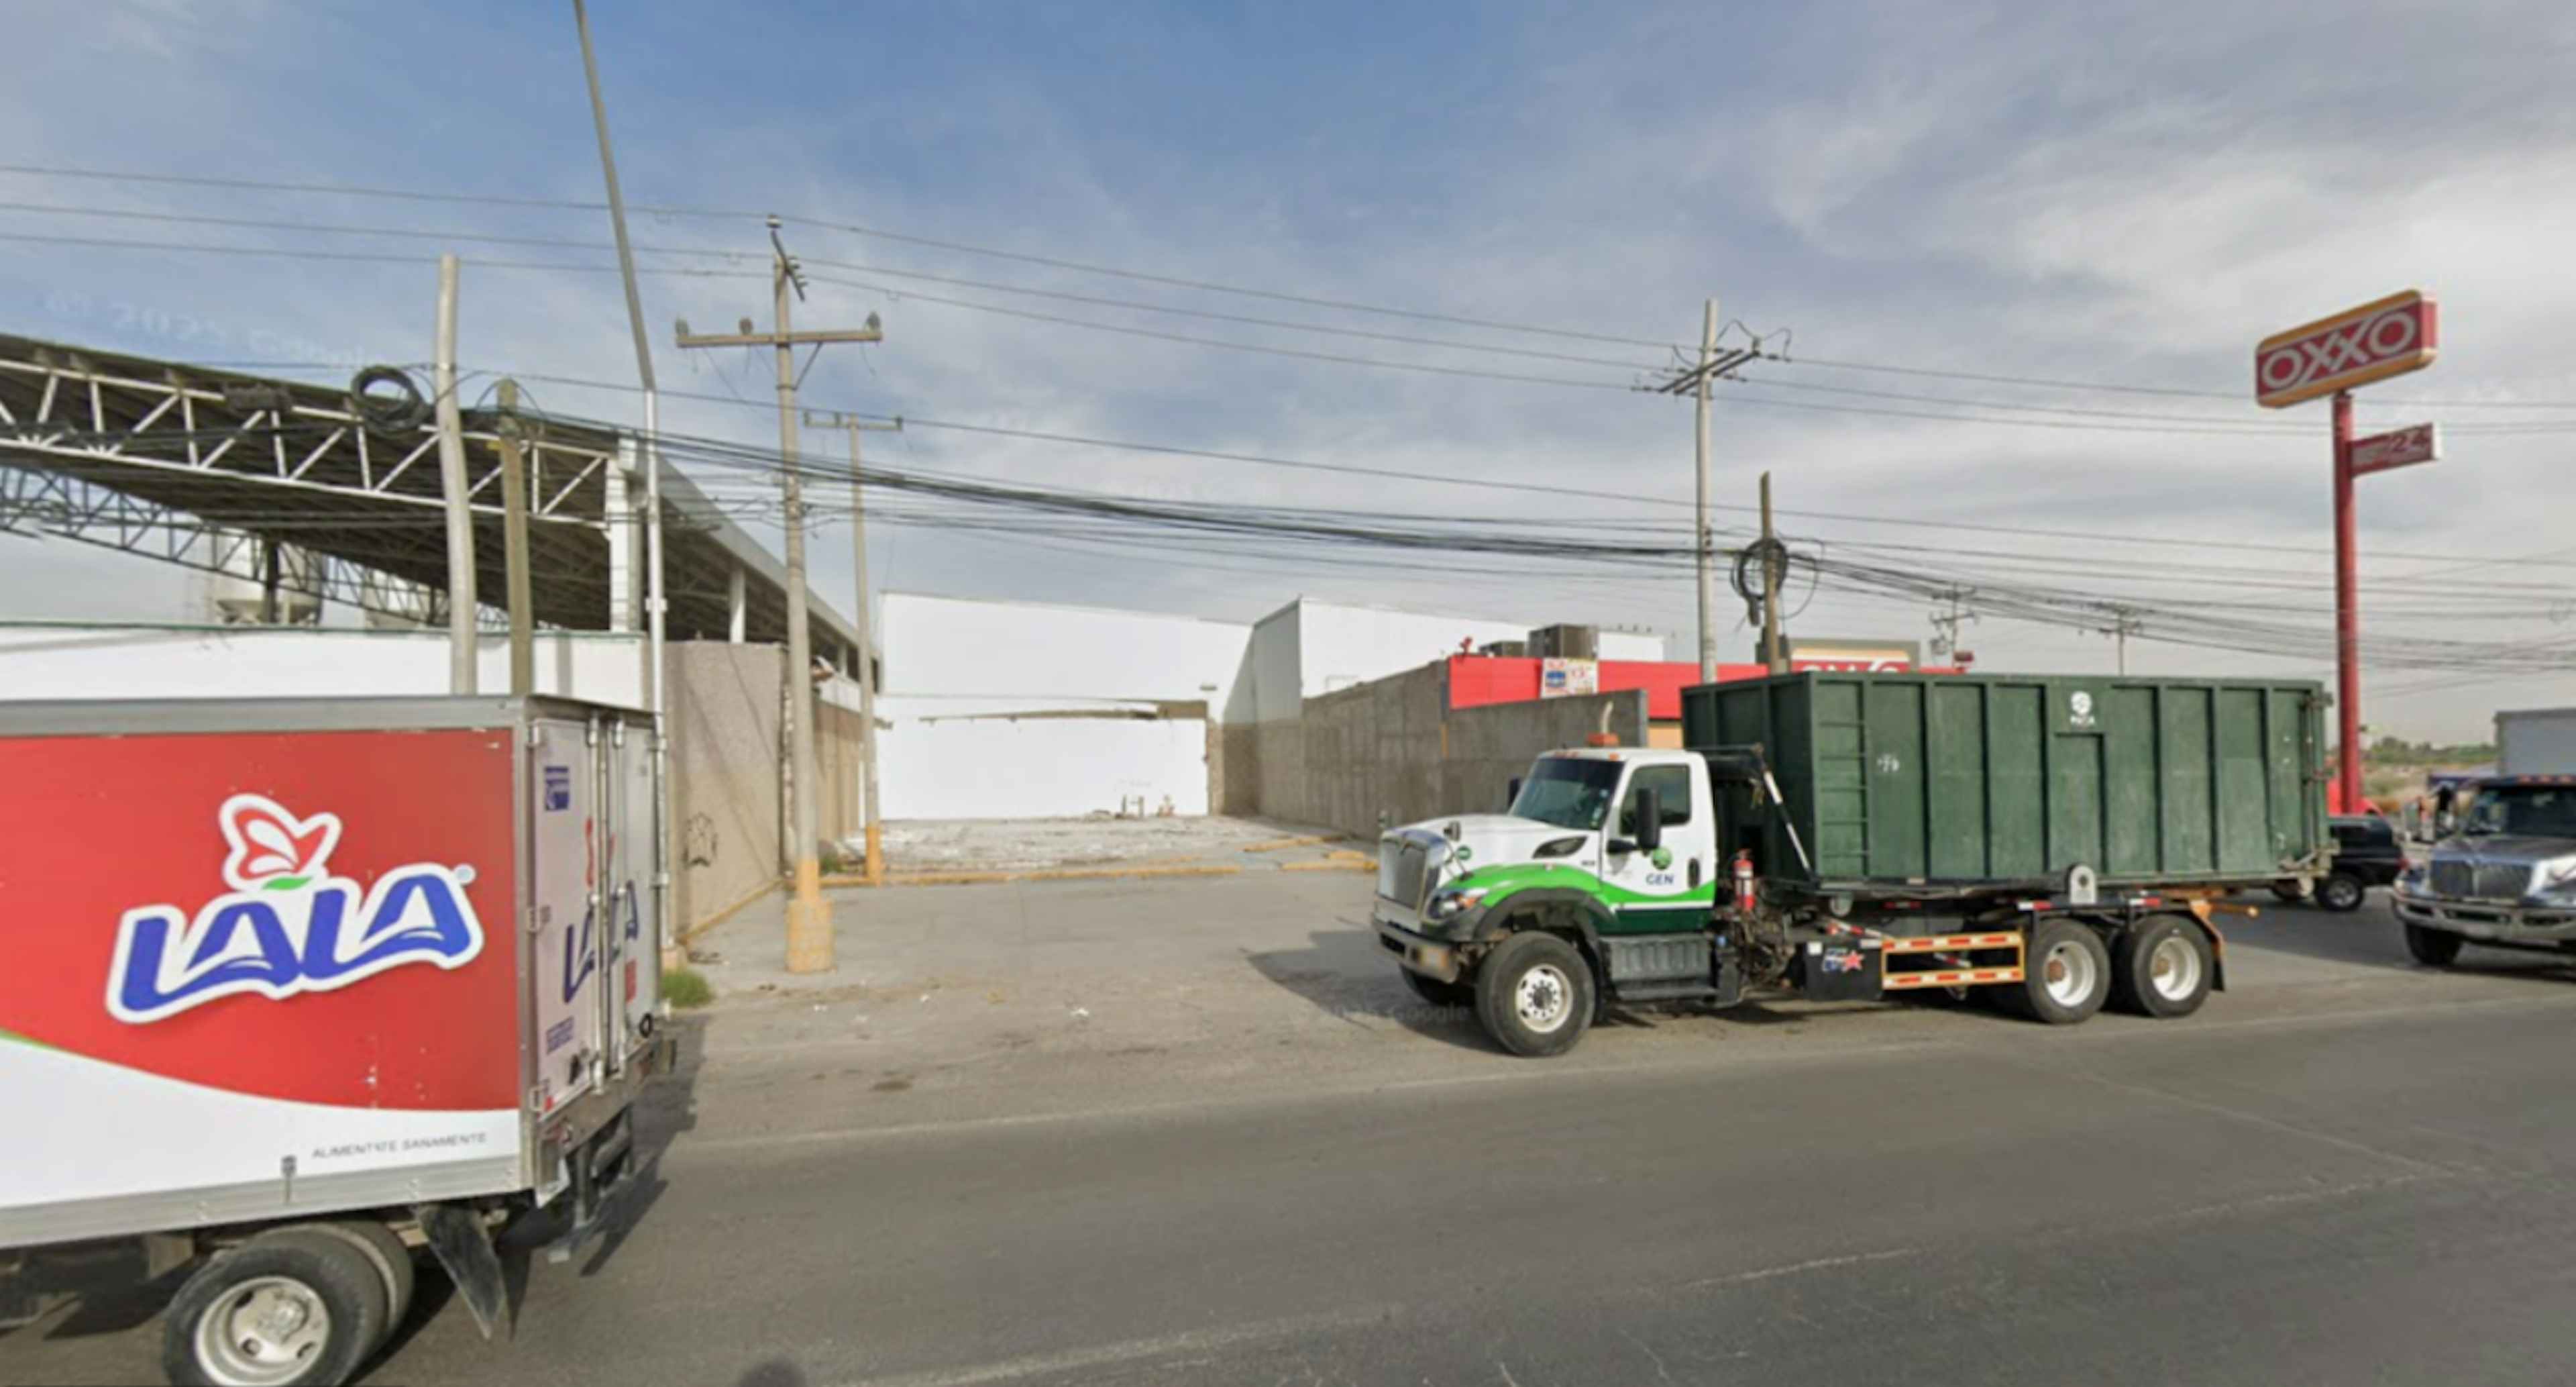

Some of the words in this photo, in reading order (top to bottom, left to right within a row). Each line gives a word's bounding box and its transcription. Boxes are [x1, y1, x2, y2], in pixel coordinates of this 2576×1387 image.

[2261, 311, 2415, 390] OXXO
[1645, 872, 1675, 886] GEN
[119, 872, 472, 1012] LALA
